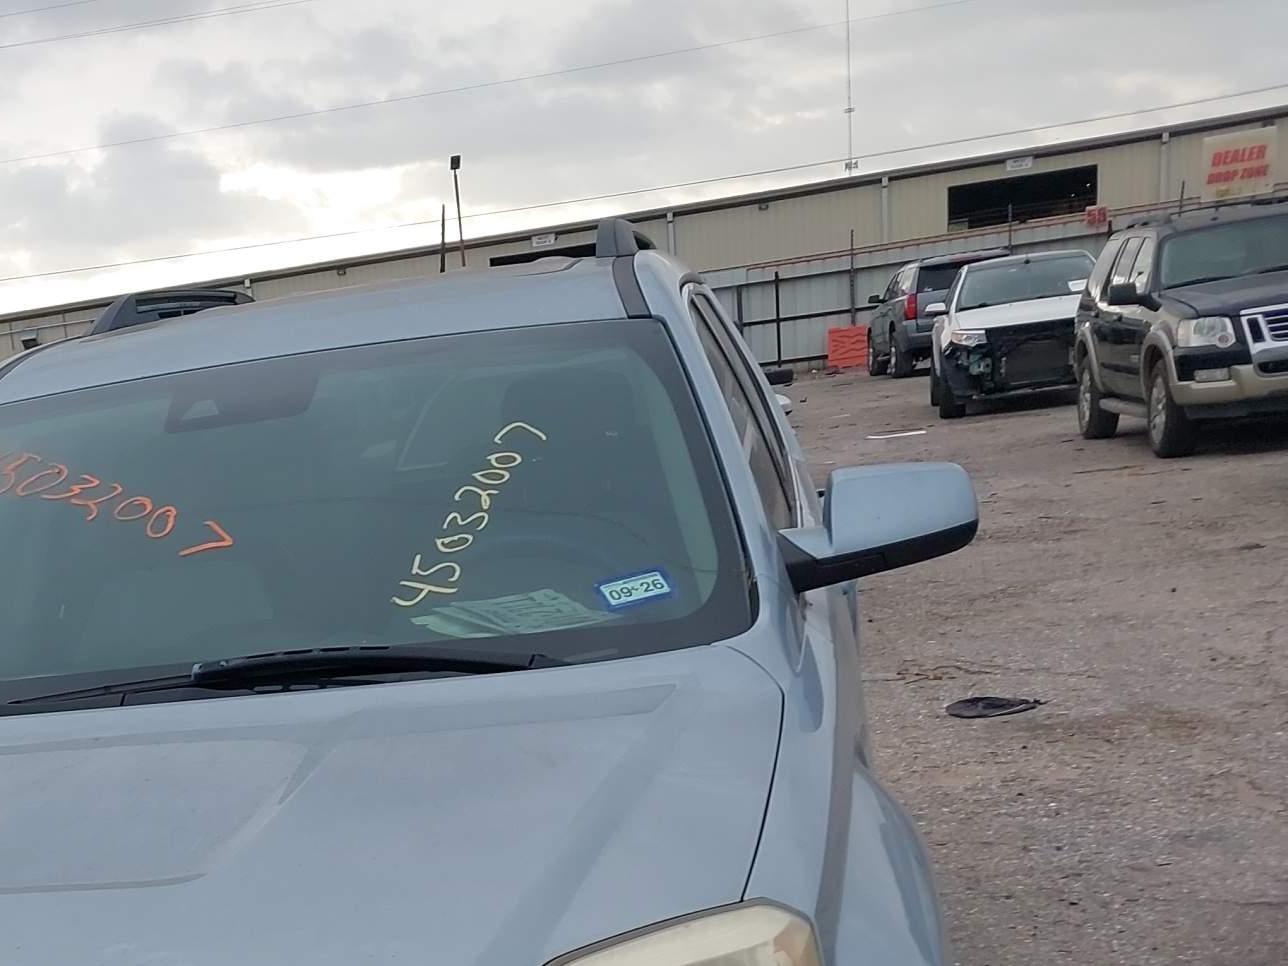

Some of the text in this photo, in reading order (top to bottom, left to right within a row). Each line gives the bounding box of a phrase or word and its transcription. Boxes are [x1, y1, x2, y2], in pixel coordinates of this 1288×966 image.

[1211, 144, 1268, 167] DEALER
[1207, 169, 1240, 185] DROP
[391, 421, 547, 608] 45032007
